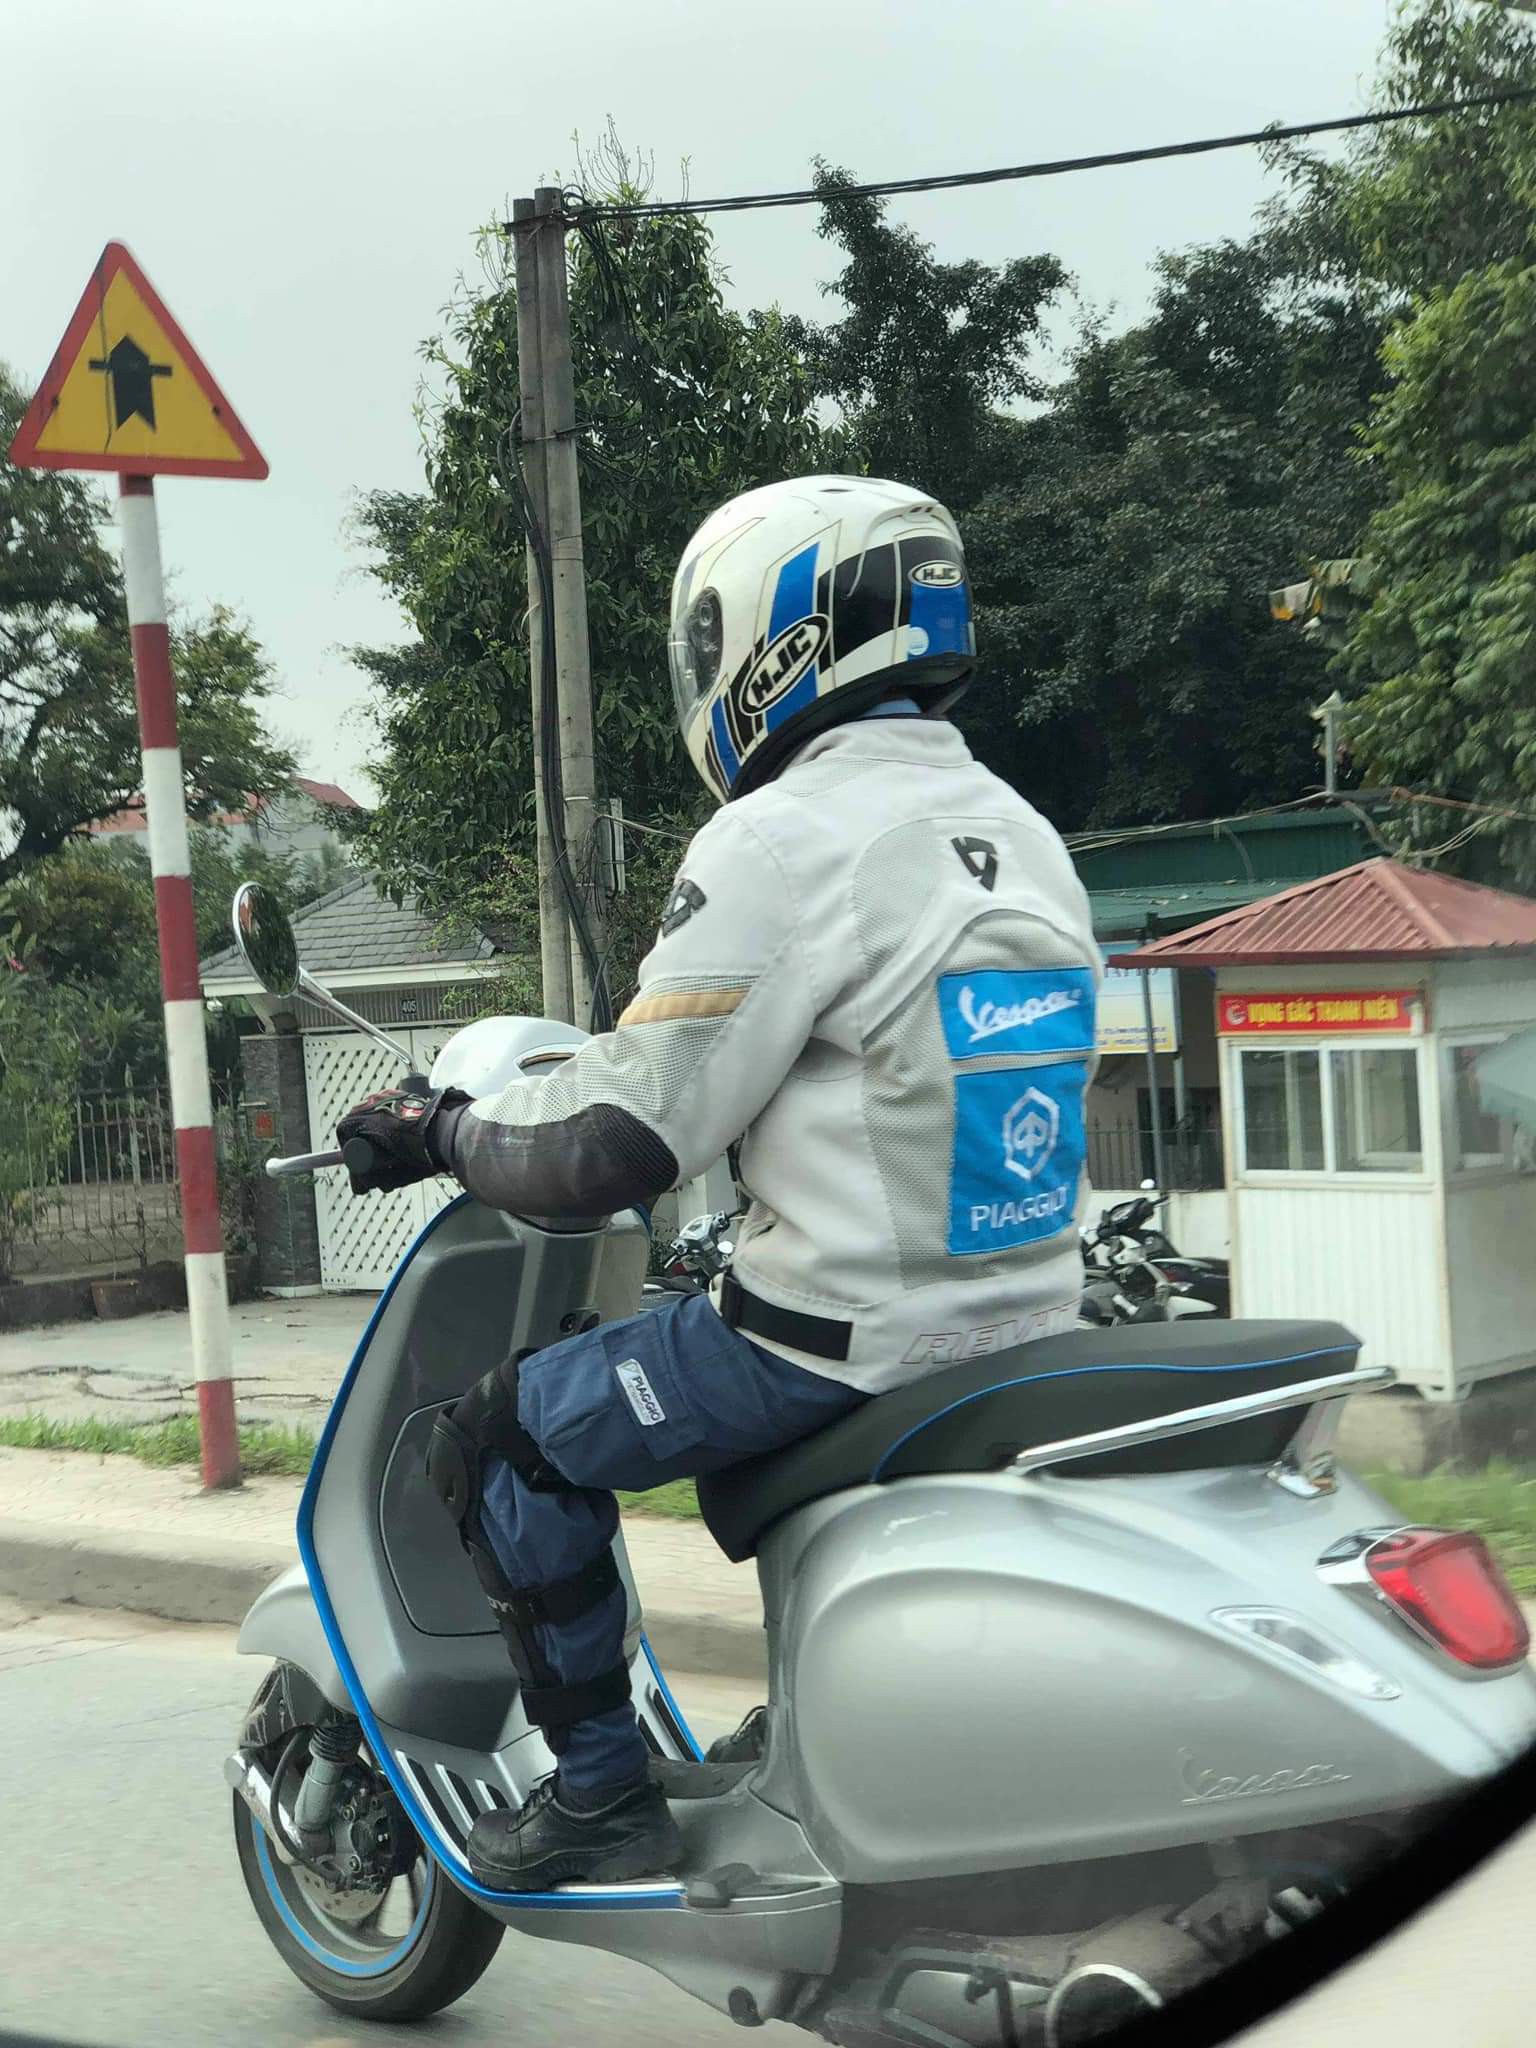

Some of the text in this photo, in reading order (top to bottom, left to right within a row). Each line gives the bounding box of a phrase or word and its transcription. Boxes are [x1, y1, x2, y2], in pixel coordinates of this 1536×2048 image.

[923, 566, 958, 580] HJC
[750, 625, 812, 705] HJC
[957, 985, 1081, 1043] Vespa
[632, 1376, 661, 1421] PIAGGIO
